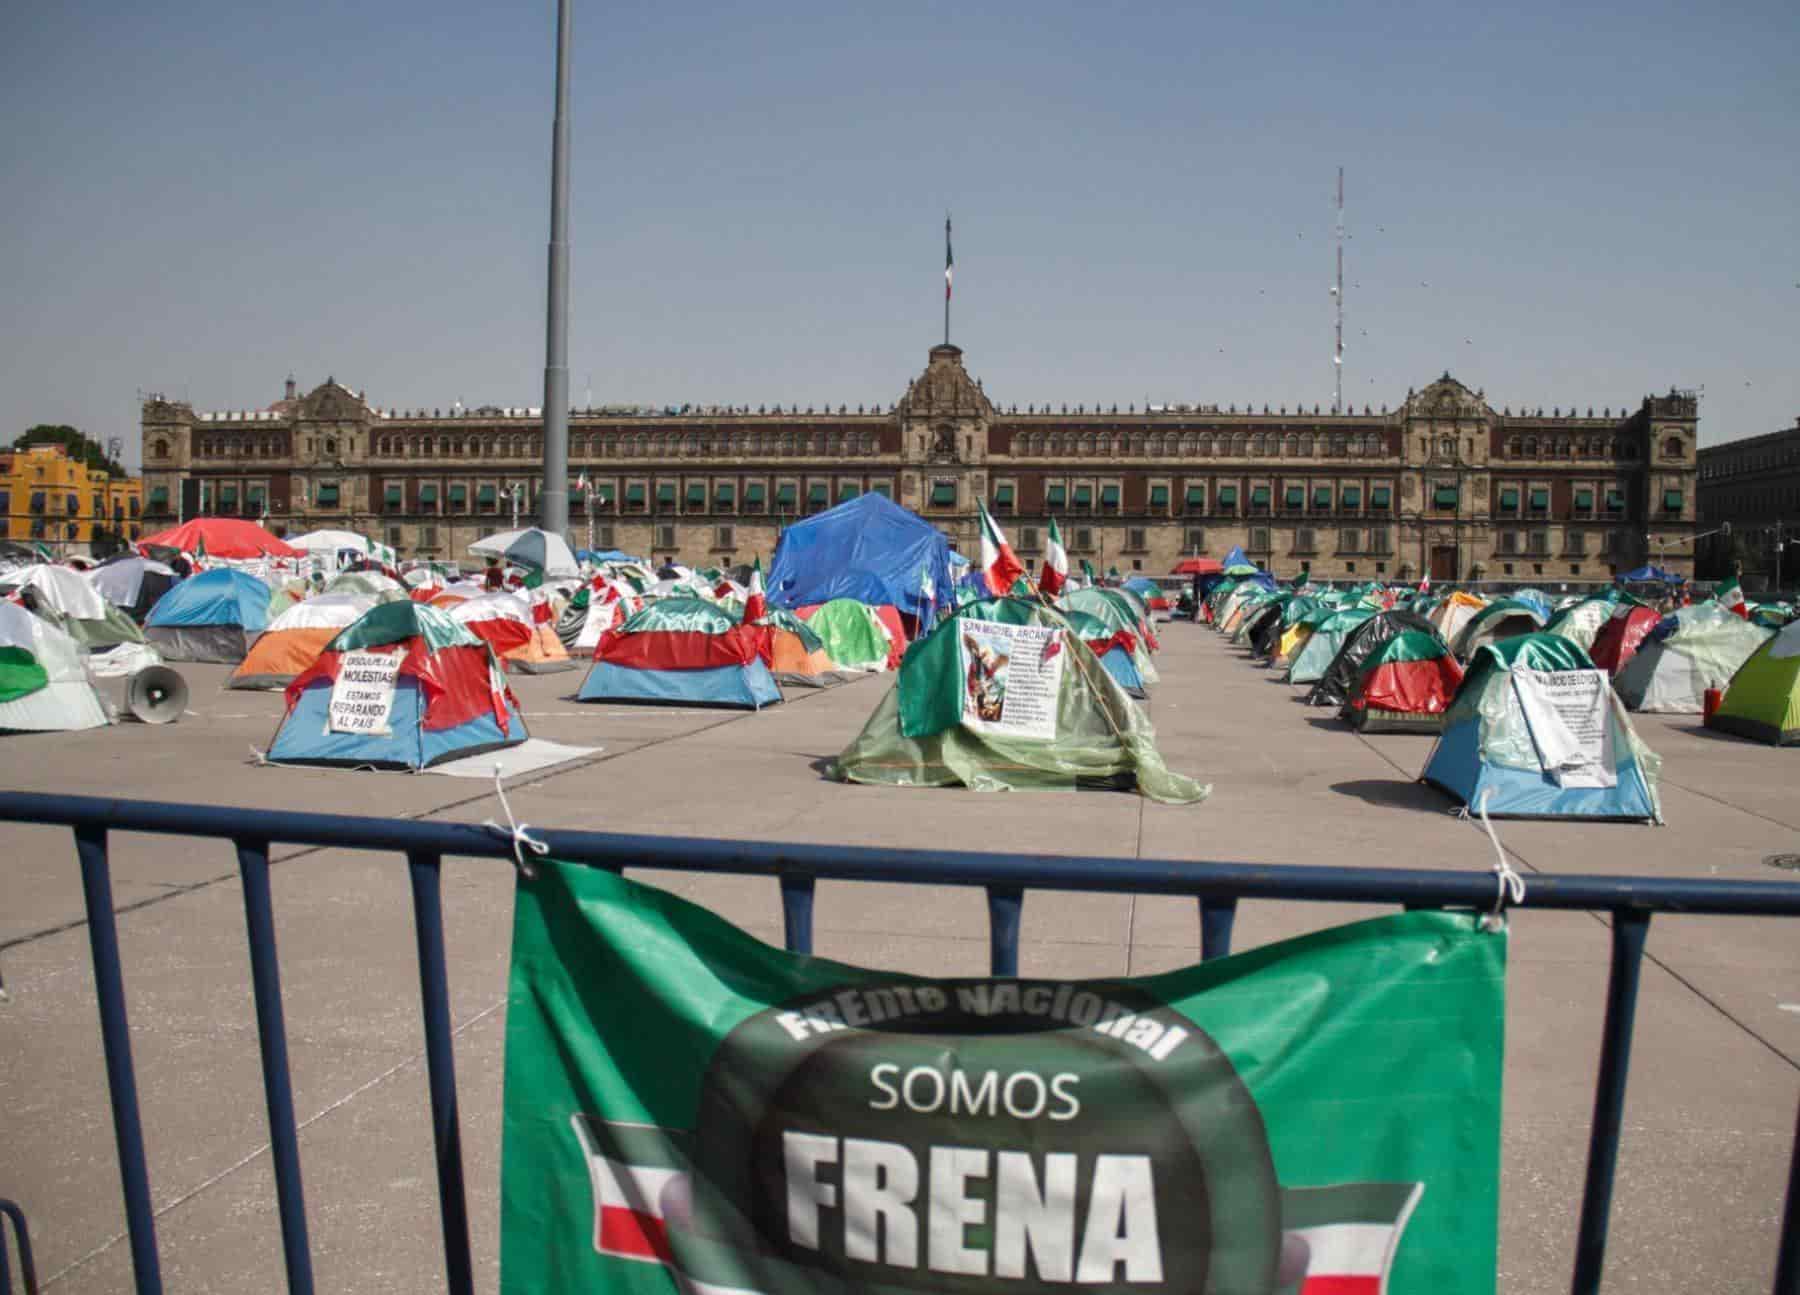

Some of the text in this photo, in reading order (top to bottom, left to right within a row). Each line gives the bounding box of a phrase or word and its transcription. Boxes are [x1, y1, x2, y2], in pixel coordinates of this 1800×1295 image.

[963, 620, 1049, 641] SAN MIGUEL ARCAN
[344, 670, 393, 683] MOLESTIAS
[346, 690, 382, 701] ESTAMOS
[333, 702, 386, 716] REPARANDO
[337, 716, 349, 728] AL
[869, 1063, 1082, 1121] SOMOS
[782, 1131, 1165, 1284] FRENA
